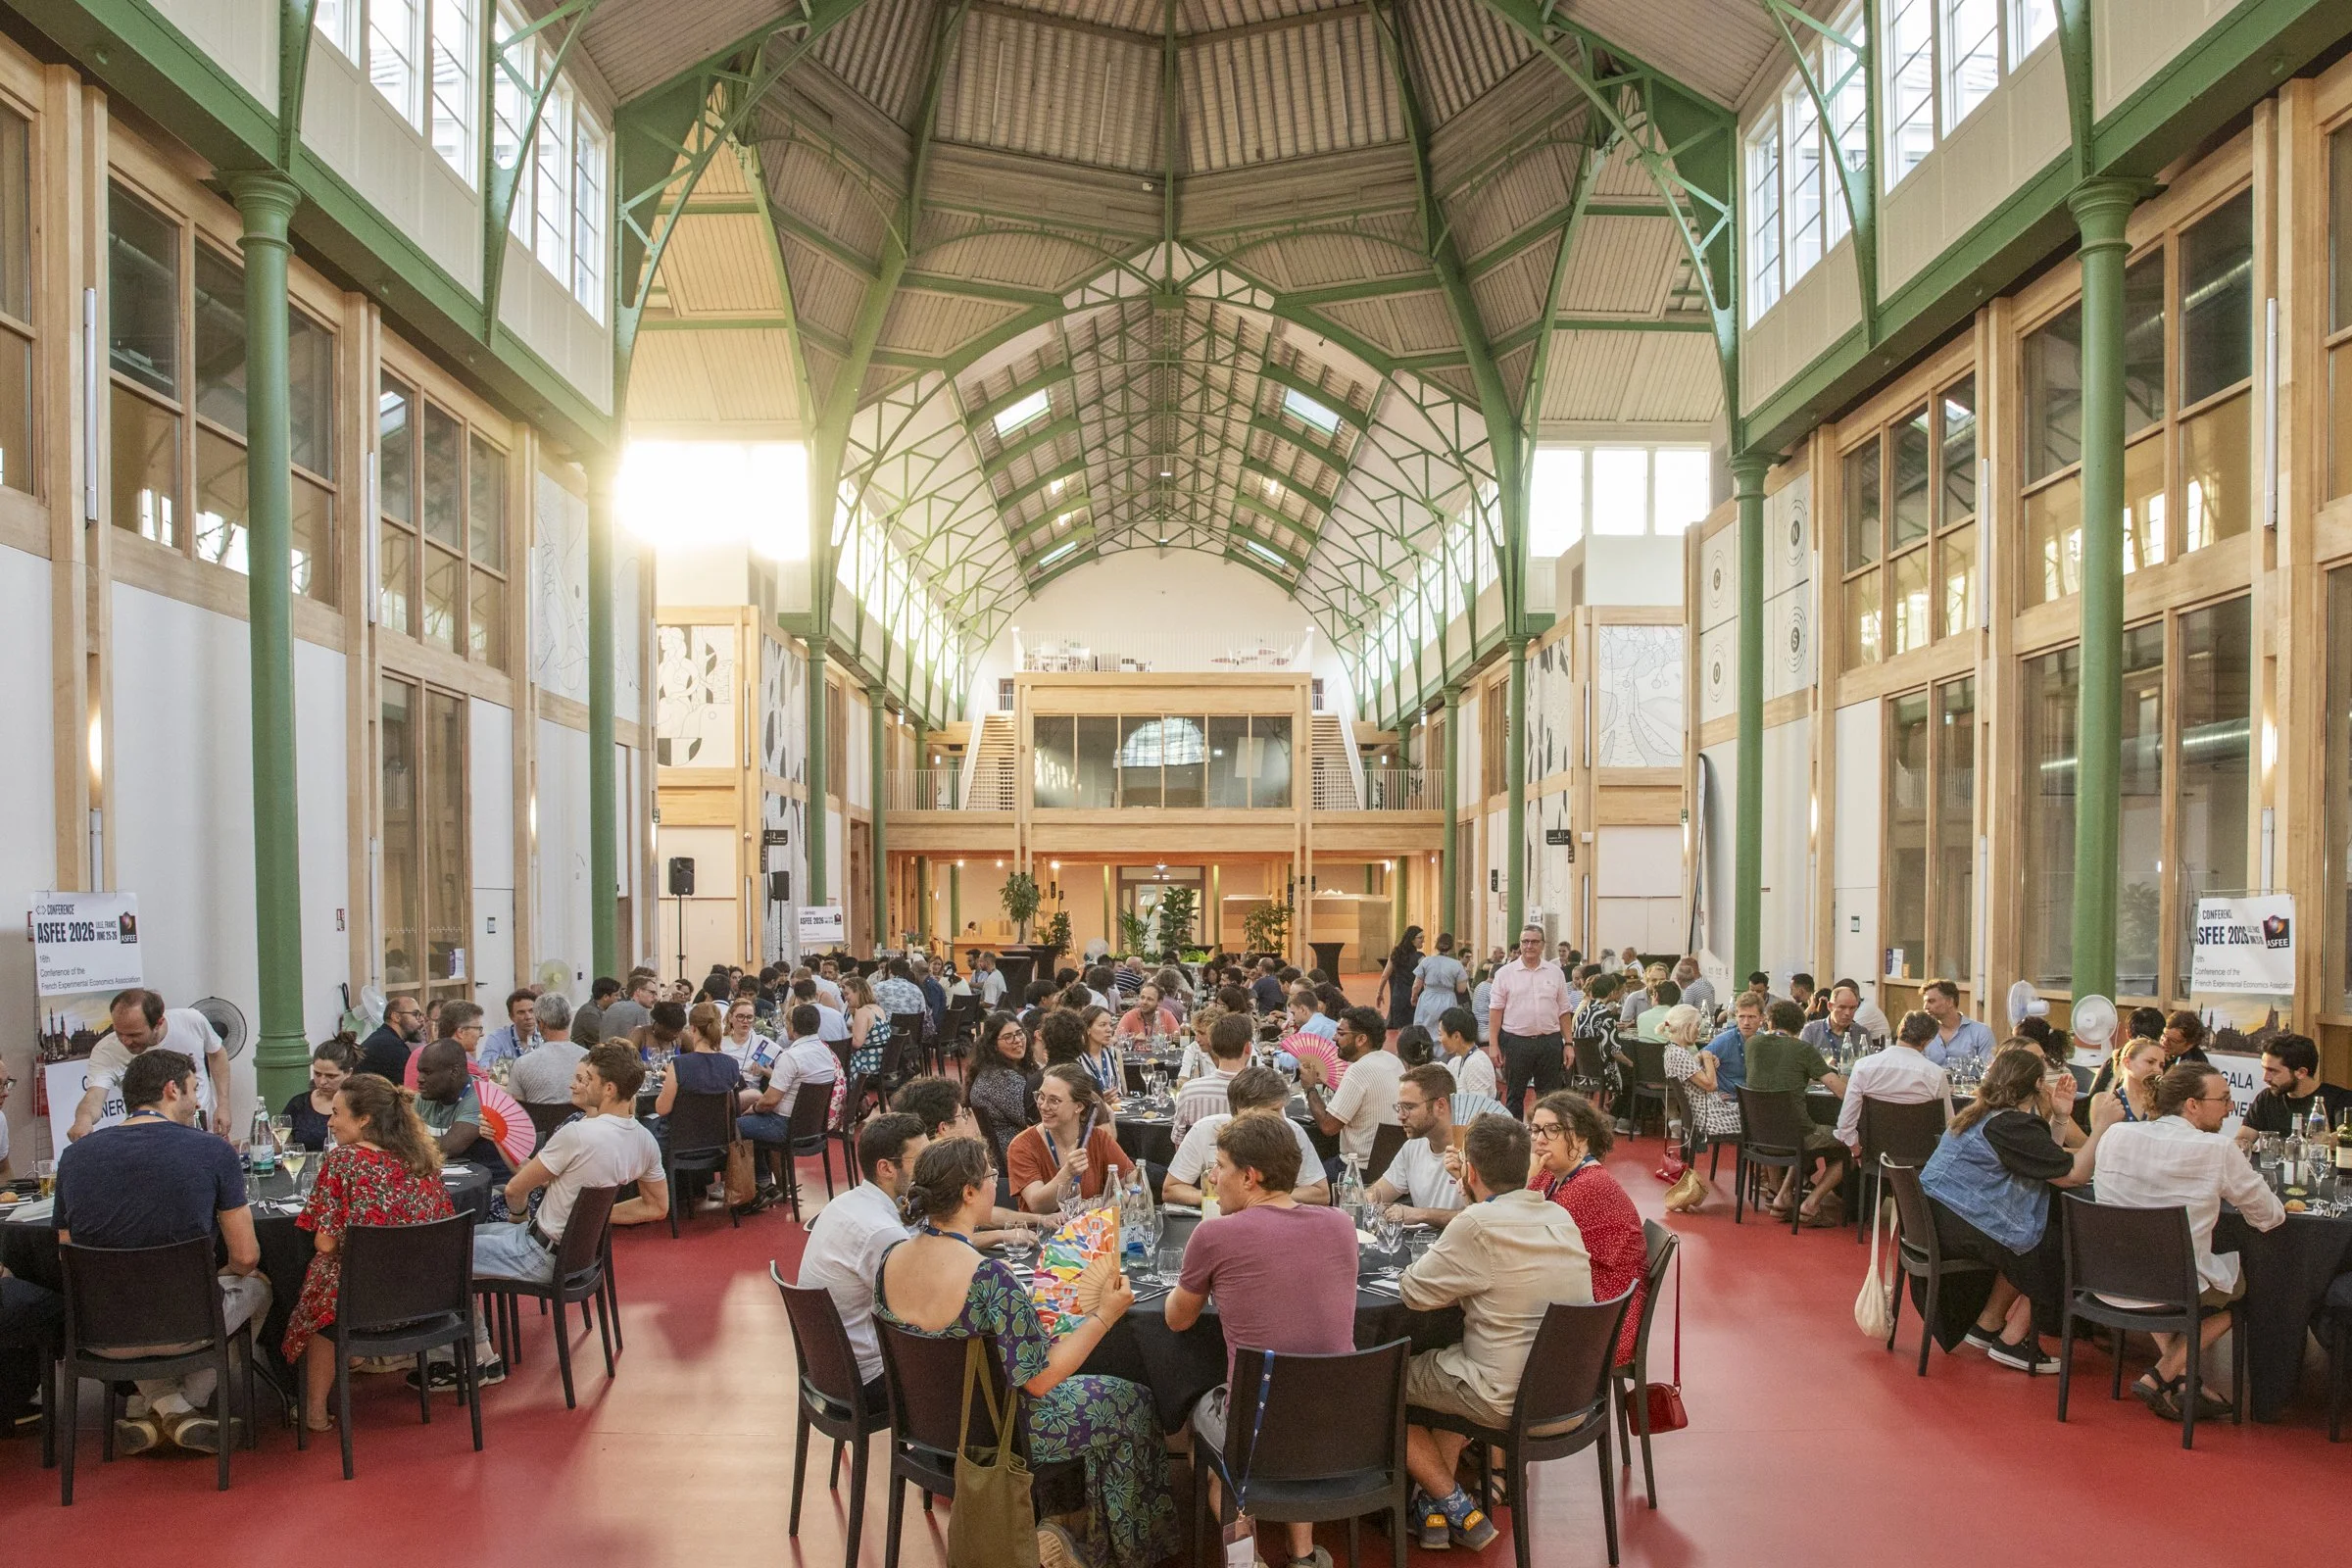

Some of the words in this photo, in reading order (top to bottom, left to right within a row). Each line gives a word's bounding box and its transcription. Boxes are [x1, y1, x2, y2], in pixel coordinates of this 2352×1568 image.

[47, 905, 74, 915] CONFERENCE
[37, 922, 67, 944] ASFEE
[69, 921, 95, 942] 2026
[97, 931, 106, 941] JUNE
[2267, 938, 2288, 948] ASFEE
[40, 968, 70, 978] Conference
[2194, 967, 2226, 976] Conference
[41, 982, 57, 991] French
[59, 980, 88, 990] Experimental
[89, 978, 114, 987] Economics
[2213, 980, 2242, 989] Experimental
